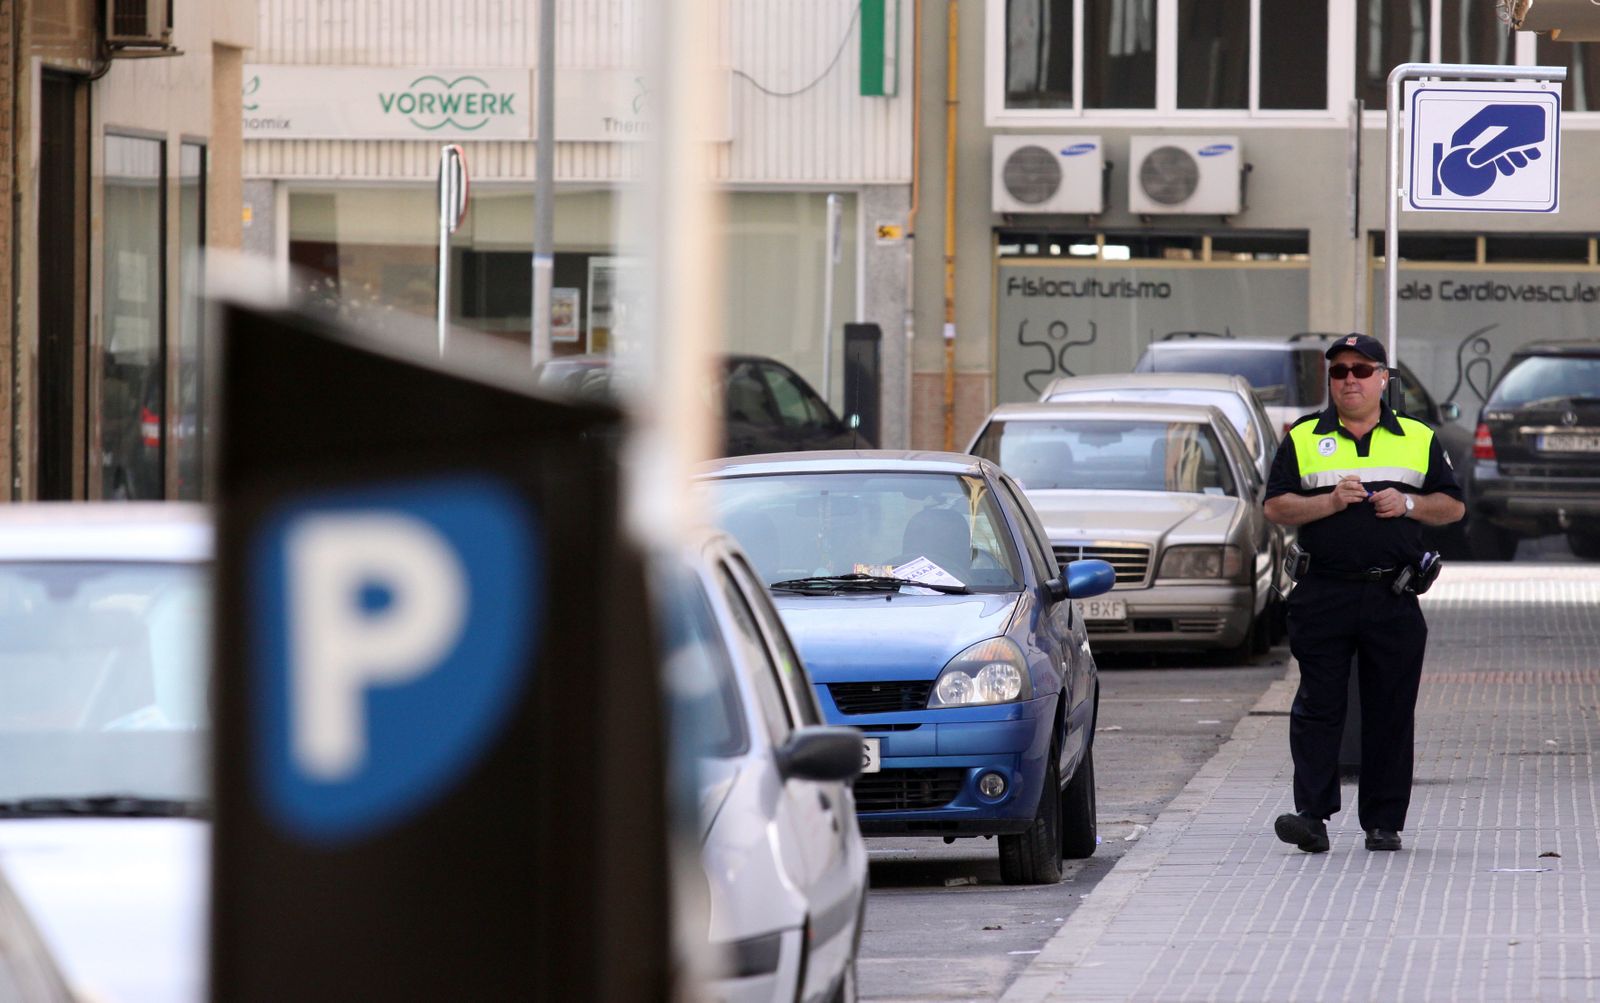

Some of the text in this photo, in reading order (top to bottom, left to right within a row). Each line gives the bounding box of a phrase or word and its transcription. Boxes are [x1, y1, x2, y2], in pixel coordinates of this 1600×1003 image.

[379, 92, 515, 114] VORWERK
[1007, 276, 1172, 298] Fisioculturismo
[1398, 280, 1432, 300] ala
[1090, 602, 1121, 617] BXF
[284, 510, 471, 783] P
